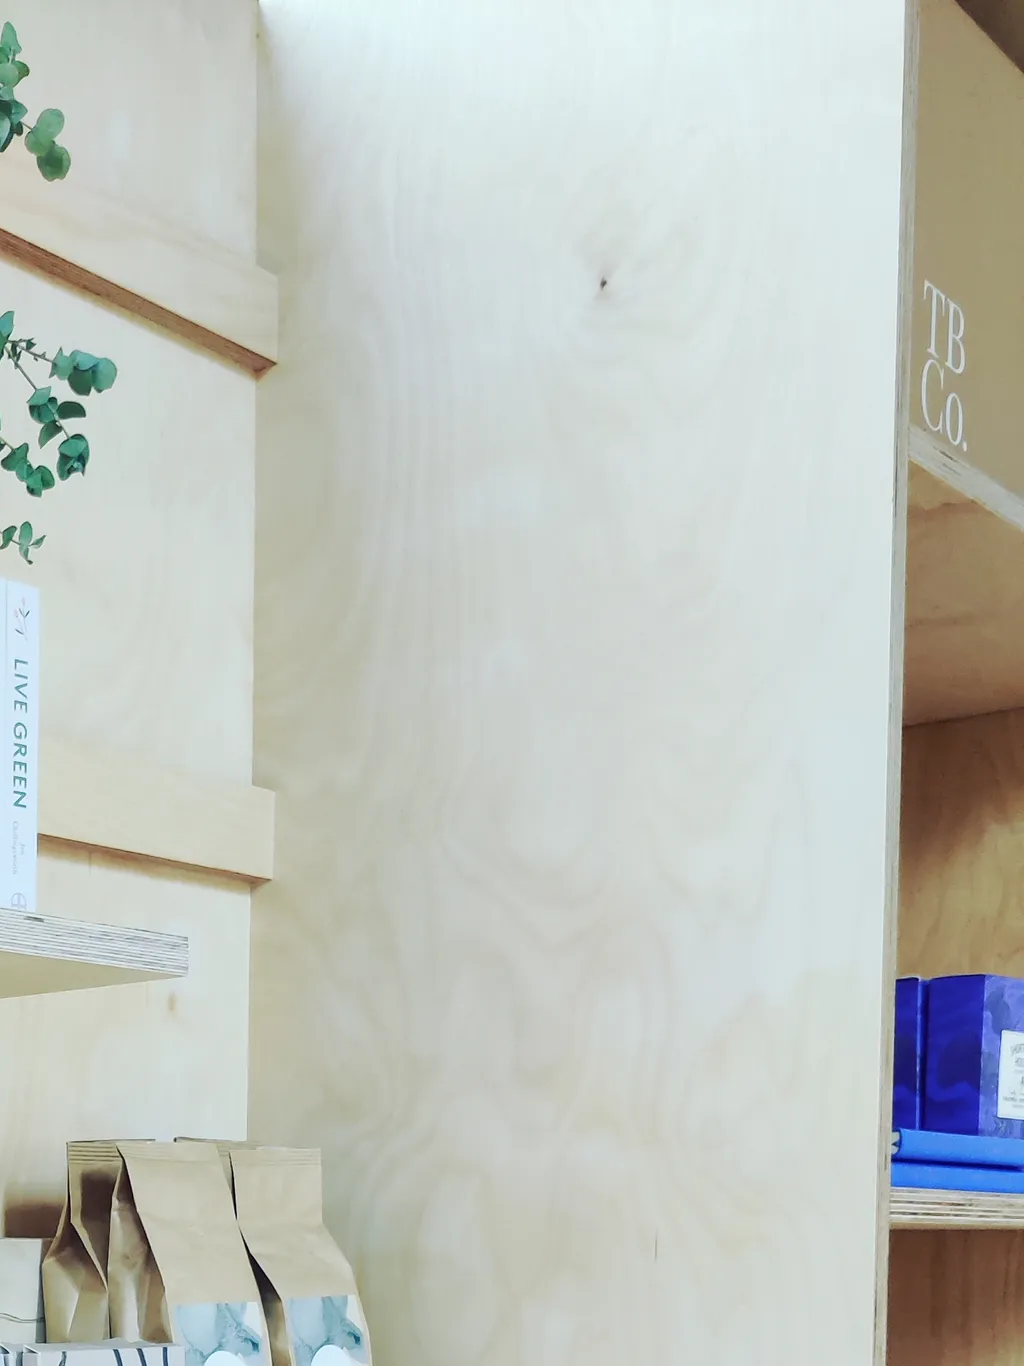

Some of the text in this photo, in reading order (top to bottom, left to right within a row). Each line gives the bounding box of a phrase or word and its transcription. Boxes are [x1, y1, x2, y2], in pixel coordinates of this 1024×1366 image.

[923, 279, 966, 374] TB
[921, 359, 968, 452] Co.
[12, 658, 28, 808] LIVE GREEN
